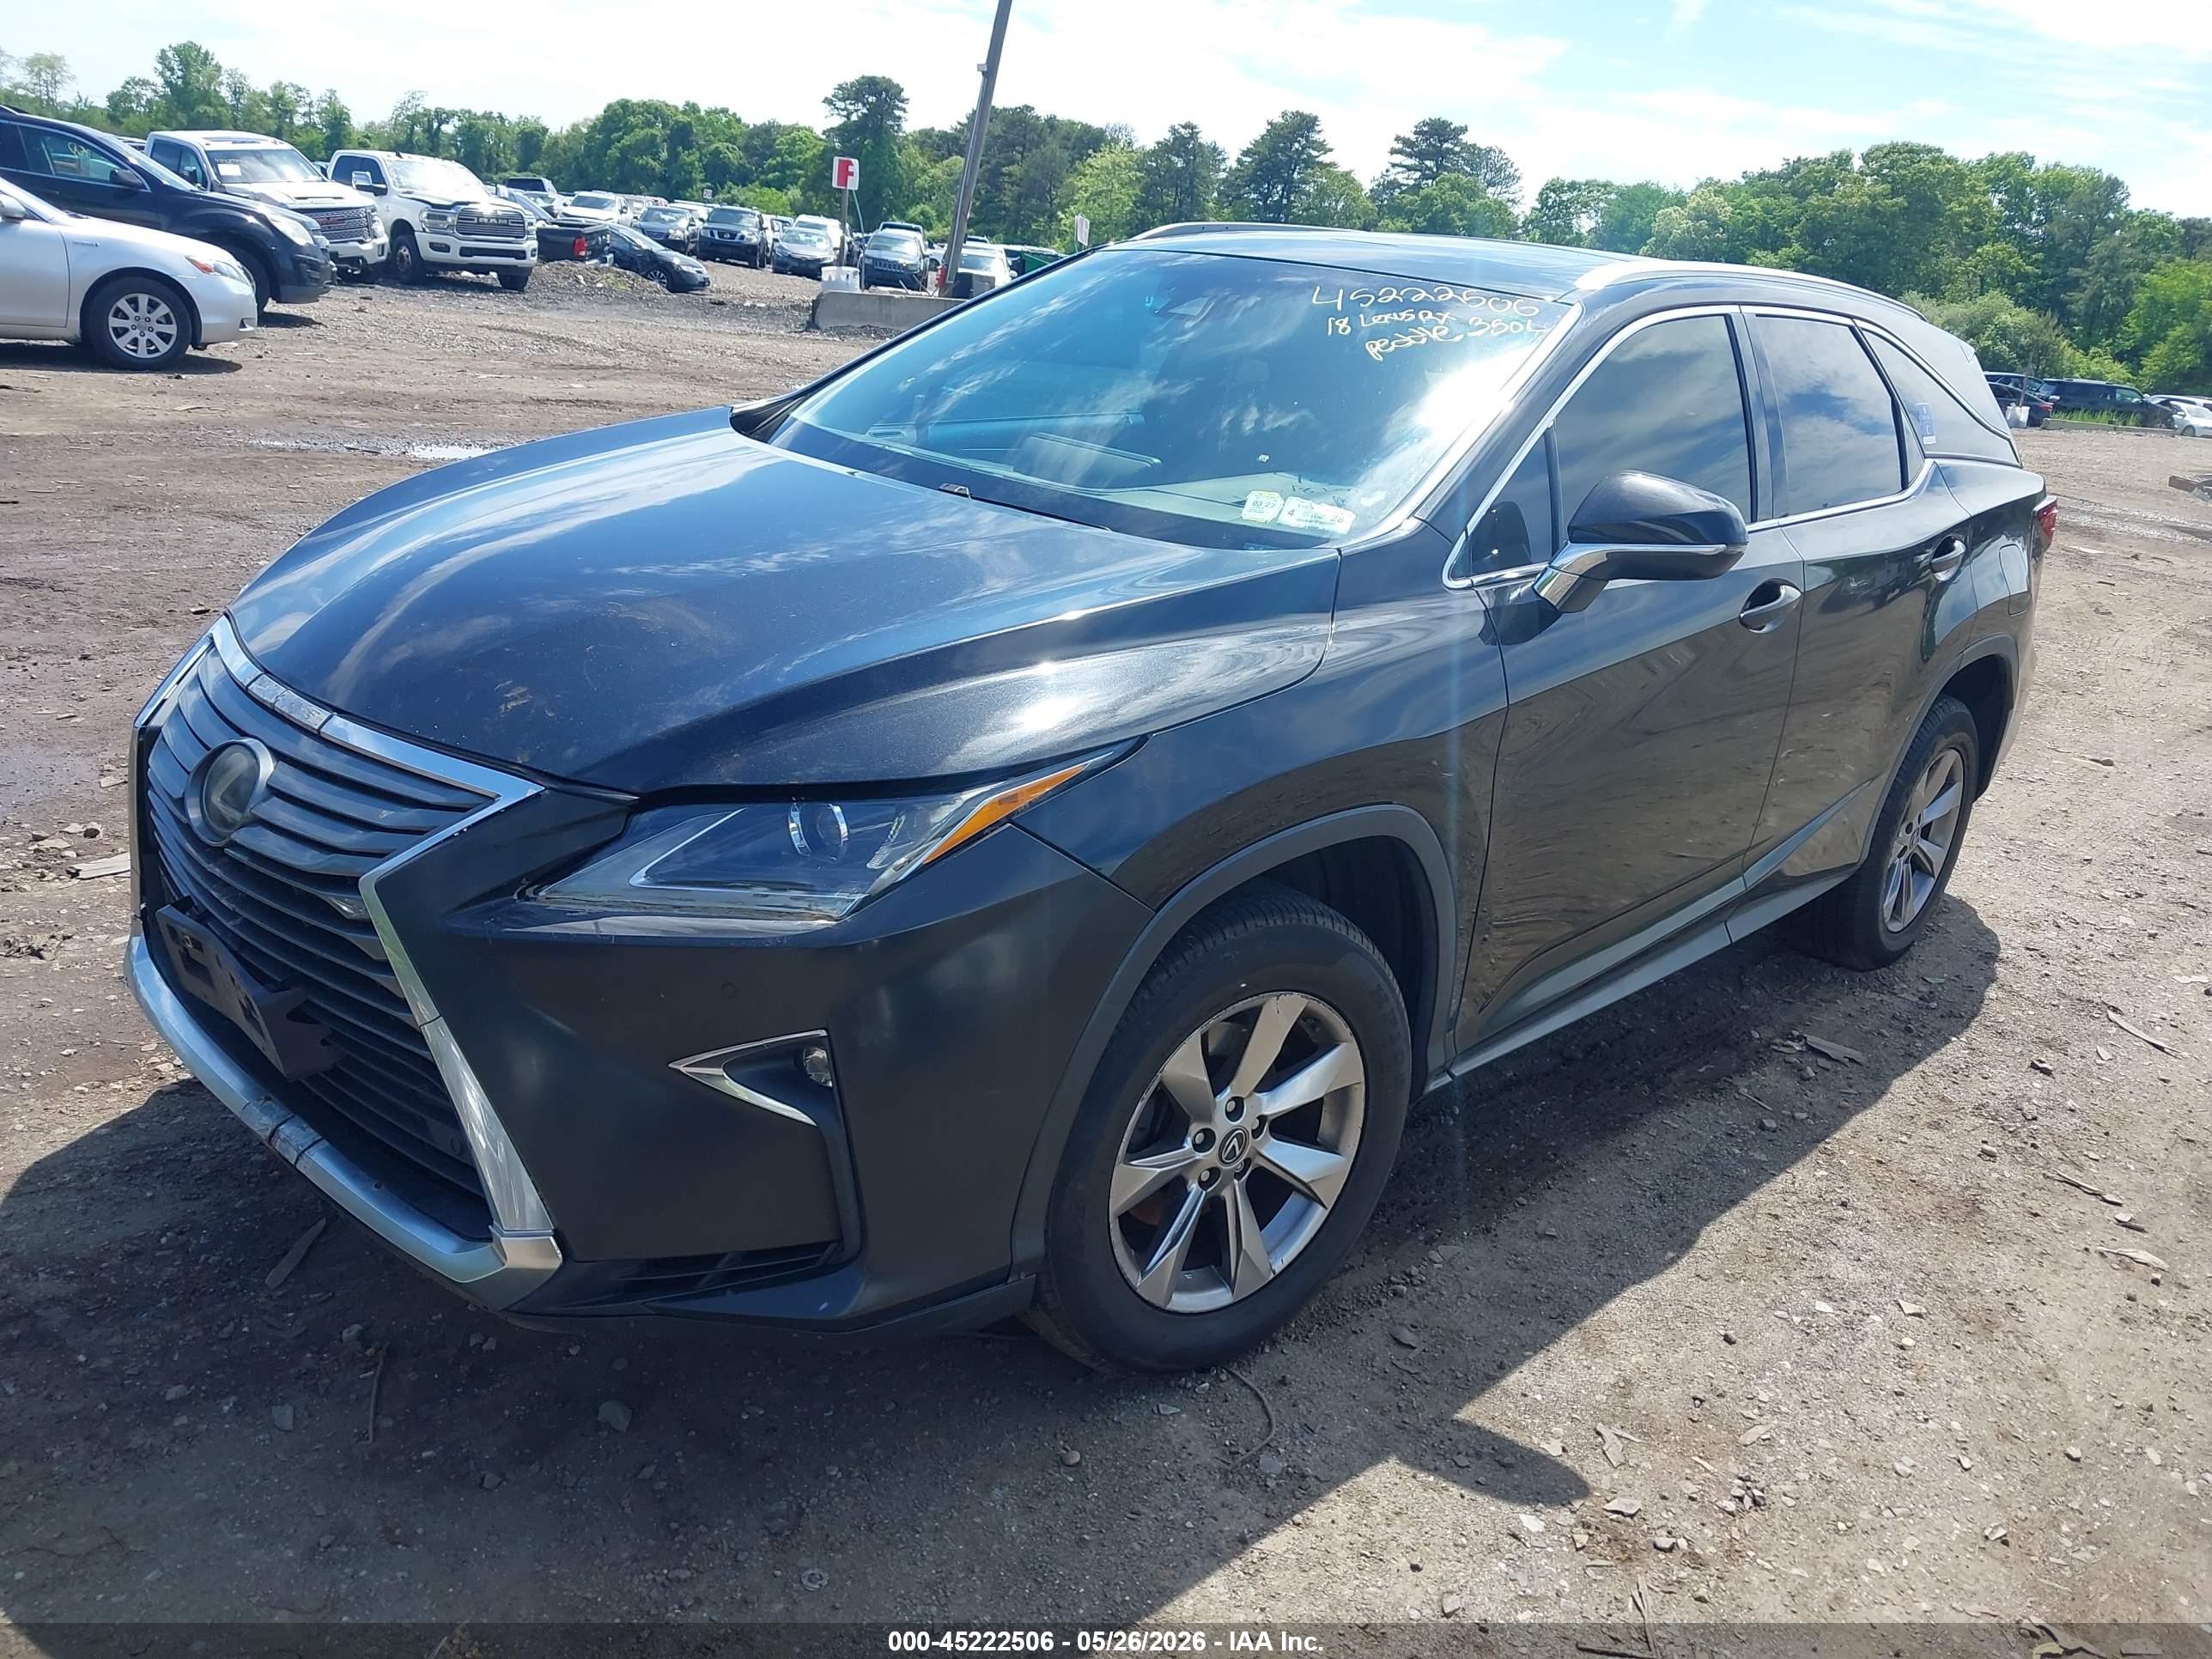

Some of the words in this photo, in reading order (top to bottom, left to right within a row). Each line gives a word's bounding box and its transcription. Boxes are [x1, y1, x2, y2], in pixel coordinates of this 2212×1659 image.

[837, 159, 854, 187] F
[1311, 285, 1540, 317] 45222506
[1327, 316, 1352, 337] 18
